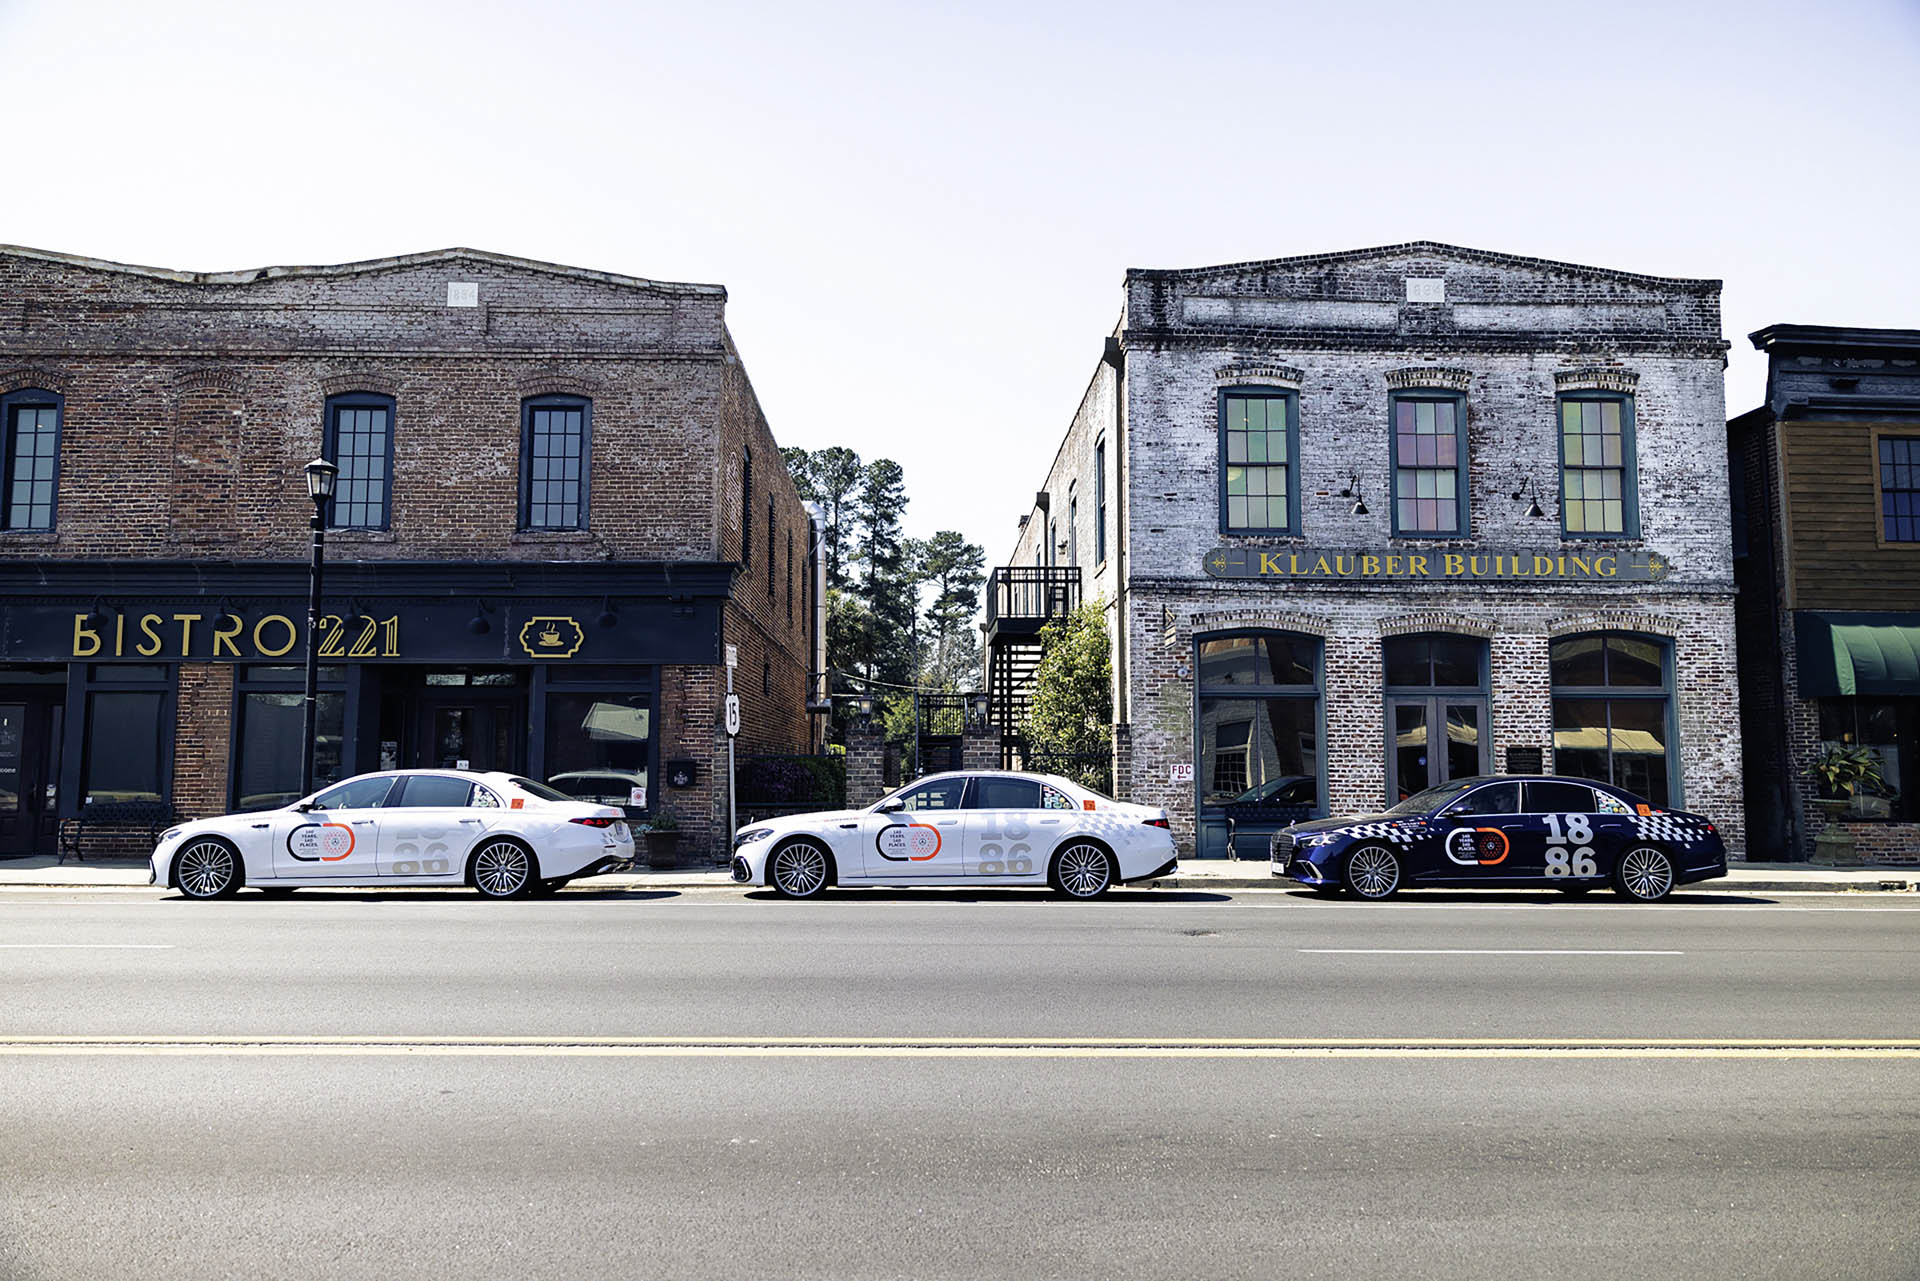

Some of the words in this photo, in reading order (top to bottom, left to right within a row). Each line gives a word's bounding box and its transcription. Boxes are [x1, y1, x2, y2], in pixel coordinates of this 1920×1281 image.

[1259, 553, 1430, 575] KLAUBER
[1444, 554, 1616, 577] BUILDING
[73, 614, 297, 656] BISTRO
[318, 615, 400, 656] 221
[729, 702, 737, 726] 15
[1172, 765, 1192, 775] FDC
[1542, 814, 1593, 845] 18
[392, 842, 449, 873] 86
[978, 843, 1033, 873] 86
[1544, 846, 1597, 878] 86
